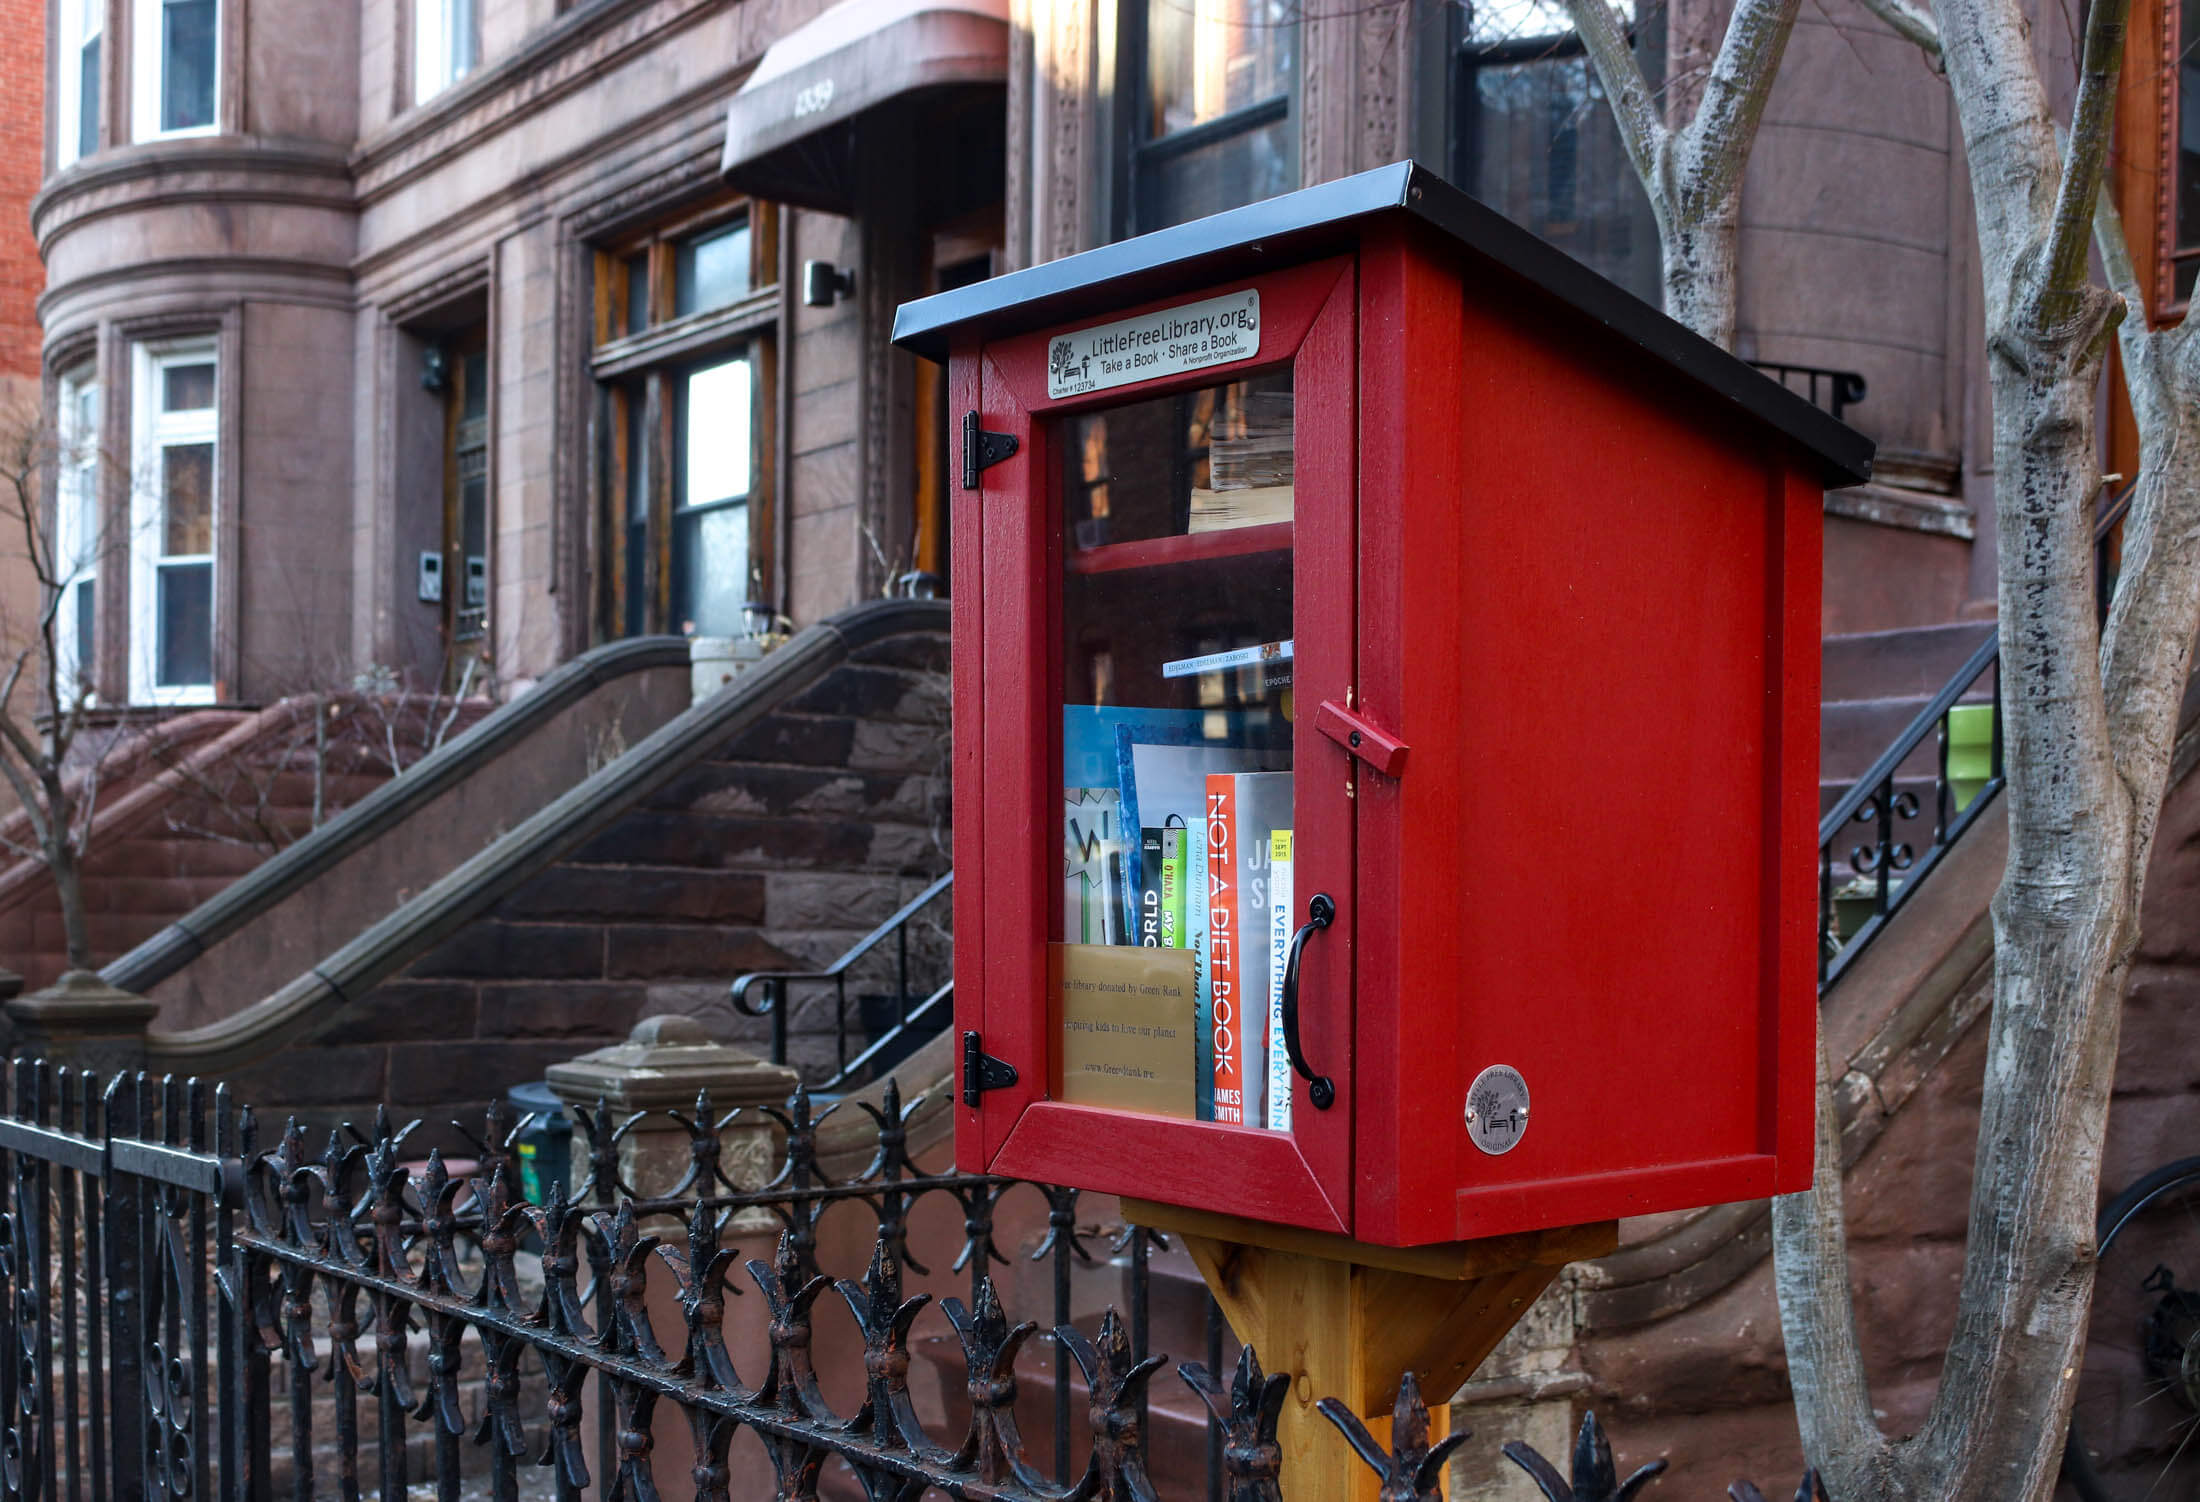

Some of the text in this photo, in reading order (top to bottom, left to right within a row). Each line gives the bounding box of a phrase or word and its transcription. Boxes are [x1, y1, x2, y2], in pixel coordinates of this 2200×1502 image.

[1092, 309, 1247, 357] LittleFreeLibrary.org
[1100, 331, 1238, 375] Take a Book Share a Book
[1189, 352, 1212, 364] Nonprofit
[1208, 794, 1234, 1075] NOT A DIET BOOK
[1073, 979, 1096, 992] library
[1098, 981, 1126, 993] donated
[1128, 983, 1137, 994] by
[1140, 984, 1160, 996] Green
[1163, 986, 1182, 997] Rank
[1153, 1026, 1177, 1040] planet
[1214, 1105, 1240, 1122] SMITH
